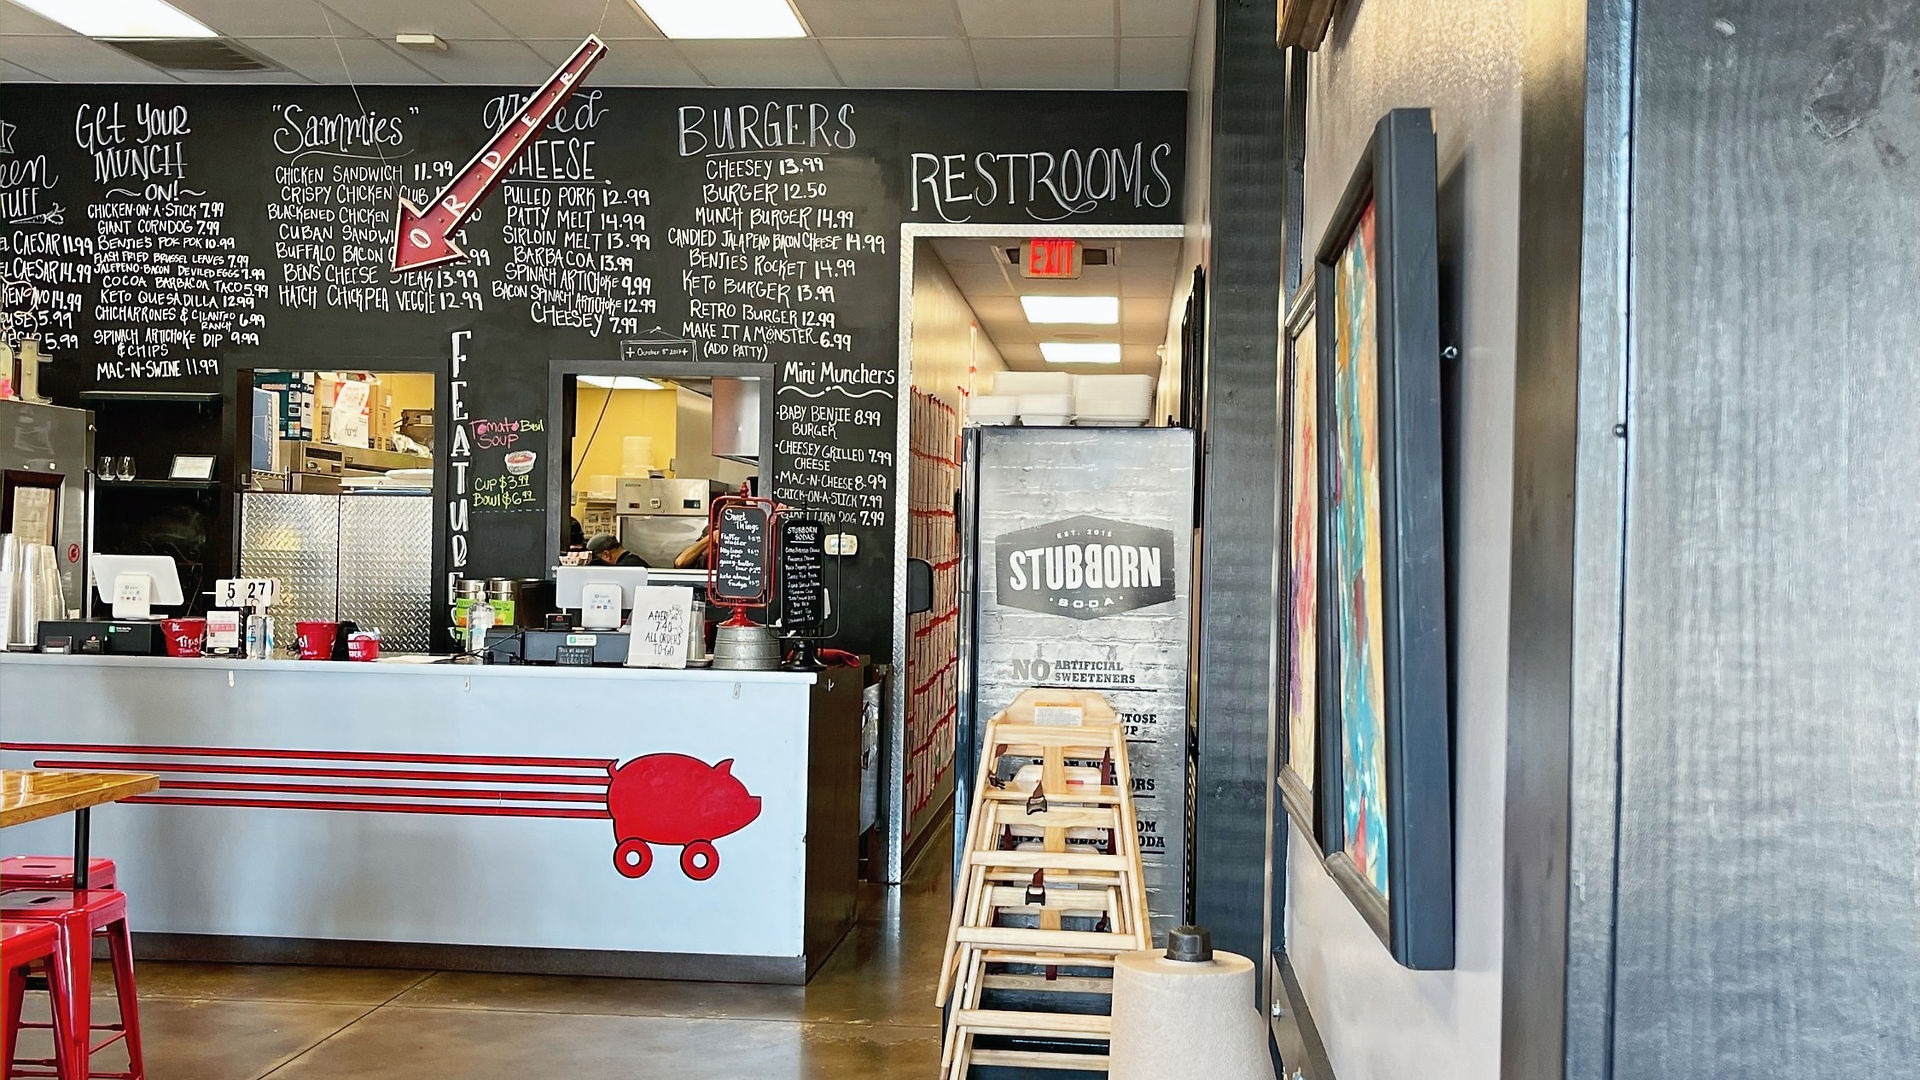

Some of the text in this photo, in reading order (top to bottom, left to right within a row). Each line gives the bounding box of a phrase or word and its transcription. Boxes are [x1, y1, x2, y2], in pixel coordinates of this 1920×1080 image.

[75, 103, 126, 154] Get
[678, 101, 856, 157] BURGERS
[95, 142, 187, 184] MUNCH
[275, 160, 453, 186] CHICKEN SANDWICH 11.99
[706, 158, 824, 181] CHEESEY 13.99
[145, 181, 179, 200] ON!
[703, 182, 826, 206] BURGER 12.50
[910, 142, 1171, 223] RESTROOMS
[281, 184, 392, 205] CRISPY CHICKEN
[504, 185, 650, 213] PULLED PORK 12.99
[200, 202, 224, 218] 7.99
[268, 204, 389, 228] BLACKENED CHICKEN
[507, 206, 550, 230] PATTY
[558, 210, 593, 232] MELT
[601, 213, 645, 230] 14.99
[696, 207, 854, 231] MUNCH BURGER 14.99
[98, 220, 132, 235] GIANT
[197, 220, 219, 235] 7.99
[279, 224, 333, 240] CUBAN
[503, 225, 650, 252] SIRLOIN MELT 13.99
[13, 230, 93, 256] CAESAR 11.99
[158, 237, 180, 249] POK
[183, 237, 202, 248] POK
[205, 237, 235, 250] 10.99
[276, 242, 335, 261] BUFFALO
[343, 244, 384, 265] BACON
[668, 228, 886, 258] CANDIED JALAPENO BACON CHEESE 14.99
[94, 251, 119, 264] FLASH
[122, 251, 148, 262] FRIED
[192, 255, 224, 265] LEAVES
[228, 255, 249, 268] 7.99
[514, 246, 633, 272] BARBACOA 13.99
[755, 255, 806, 280] ROCKET
[815, 259, 856, 280] 14.99
[1030, 239, 1076, 275] EXIT
[13, 257, 91, 284] CAESAR 14.99
[178, 265, 265, 280] DEVILED EGGS 7.99
[325, 264, 478, 288] CHEESE 13.99
[505, 262, 650, 298] SPINACH ARTICHOKE 9.99
[103, 275, 147, 288] COCOA
[214, 280, 242, 293] TACO
[243, 284, 268, 298] 5.99
[492, 280, 656, 316] BACON SPINACH ARTICHOKE 12.99
[683, 270, 835, 308] KETO BURGER 13.99
[52, 290, 82, 312] 14.99
[101, 289, 132, 304] KETO
[223, 296, 255, 309] 12.99
[279, 285, 483, 313] HATCH CHICKPEA VEGGIE 12.99
[38, 310, 73, 330] 5.99
[95, 305, 176, 323] CHICHARRONES
[180, 307, 188, 326] &
[240, 313, 265, 328] 6.99
[201, 321, 231, 332] RANCH
[531, 301, 637, 337] CHEESEY 7.99
[690, 299, 835, 331] RETRO BURGER 12.99
[45, 332, 79, 350] 5.99
[94, 328, 259, 349] SPINACH ARTICHOKE DIP 9.99
[683, 322, 851, 351] MAKE IT A 6.99
[704, 341, 768, 362] (ADD PATTY)
[97, 358, 219, 381] MAC-N-SWINE 11.99
[783, 362, 895, 384] Mini Munchers
[780, 405, 807, 422] BABY
[855, 409, 880, 426] 8.99
[469, 417, 544, 440] Tomato Basil
[792, 422, 837, 439] BURGER
[779, 440, 892, 466] CHEESEY GRILLED 7.99
[794, 457, 830, 471] CHEESE
[780, 471, 886, 490] MAC-N-CHEESE 8.99
[859, 495, 883, 509] 7.99
[860, 511, 885, 526] 7.99
[1009, 544, 1161, 591] STUBBORN
[227, 583, 265, 598] 5 27
[1058, 598, 1114, 608] SODA
[1011, 659, 1050, 681] NO
[1055, 661, 1123, 671] ARTIFICIAL
[1055, 673, 1136, 683] SWEETENERS
